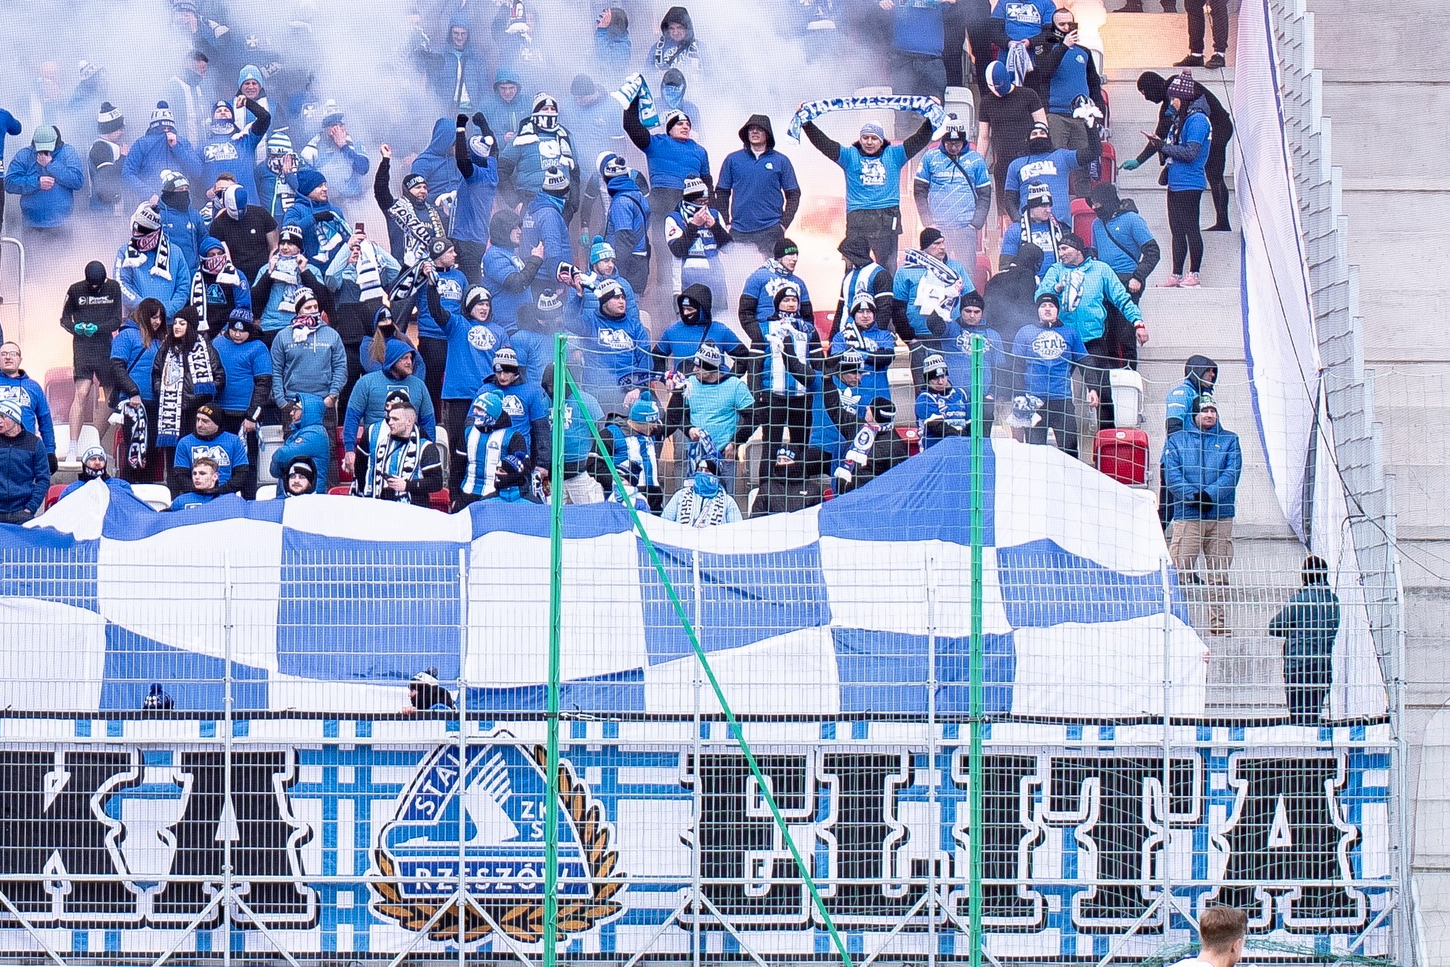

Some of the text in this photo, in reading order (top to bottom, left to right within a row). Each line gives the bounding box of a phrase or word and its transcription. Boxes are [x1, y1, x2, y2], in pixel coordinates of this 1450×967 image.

[193, 340, 208, 380] RZES
[1033, 337, 1067, 350] STAL
[163, 387, 179, 431] ELITA
[681, 744, 1370, 934] ELITA
